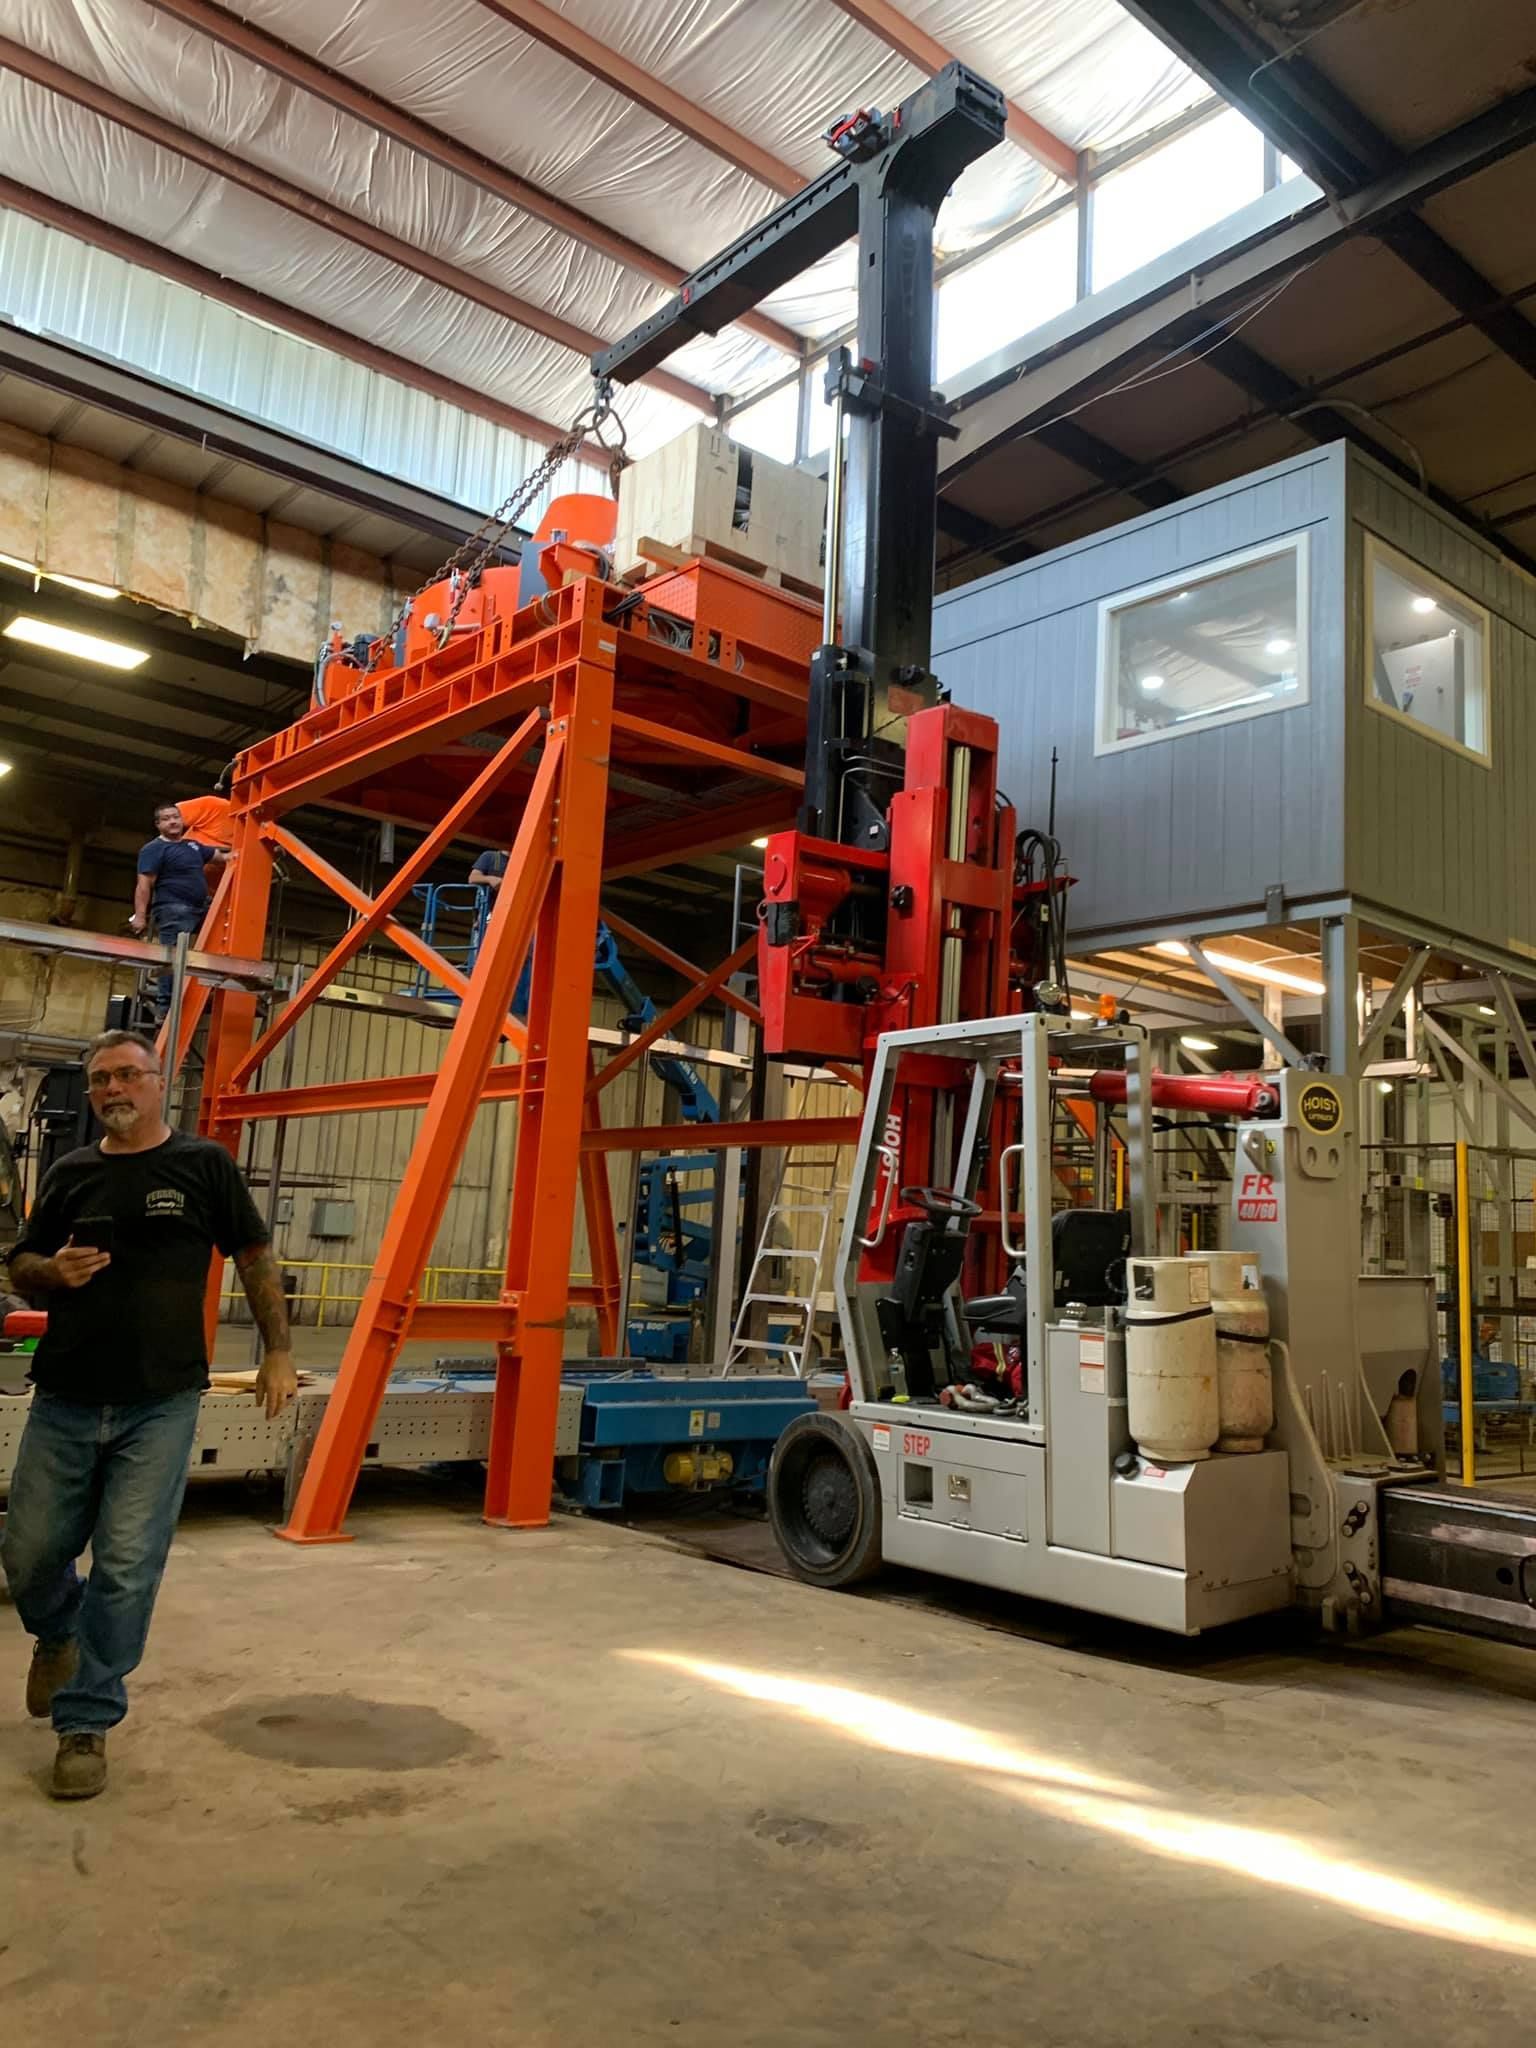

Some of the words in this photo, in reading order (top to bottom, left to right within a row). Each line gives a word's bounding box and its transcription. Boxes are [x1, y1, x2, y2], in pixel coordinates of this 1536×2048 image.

[1303, 1097, 1336, 1113] HOIST
[1241, 1173, 1273, 1196] FR
[903, 1433, 931, 1456] STEP
